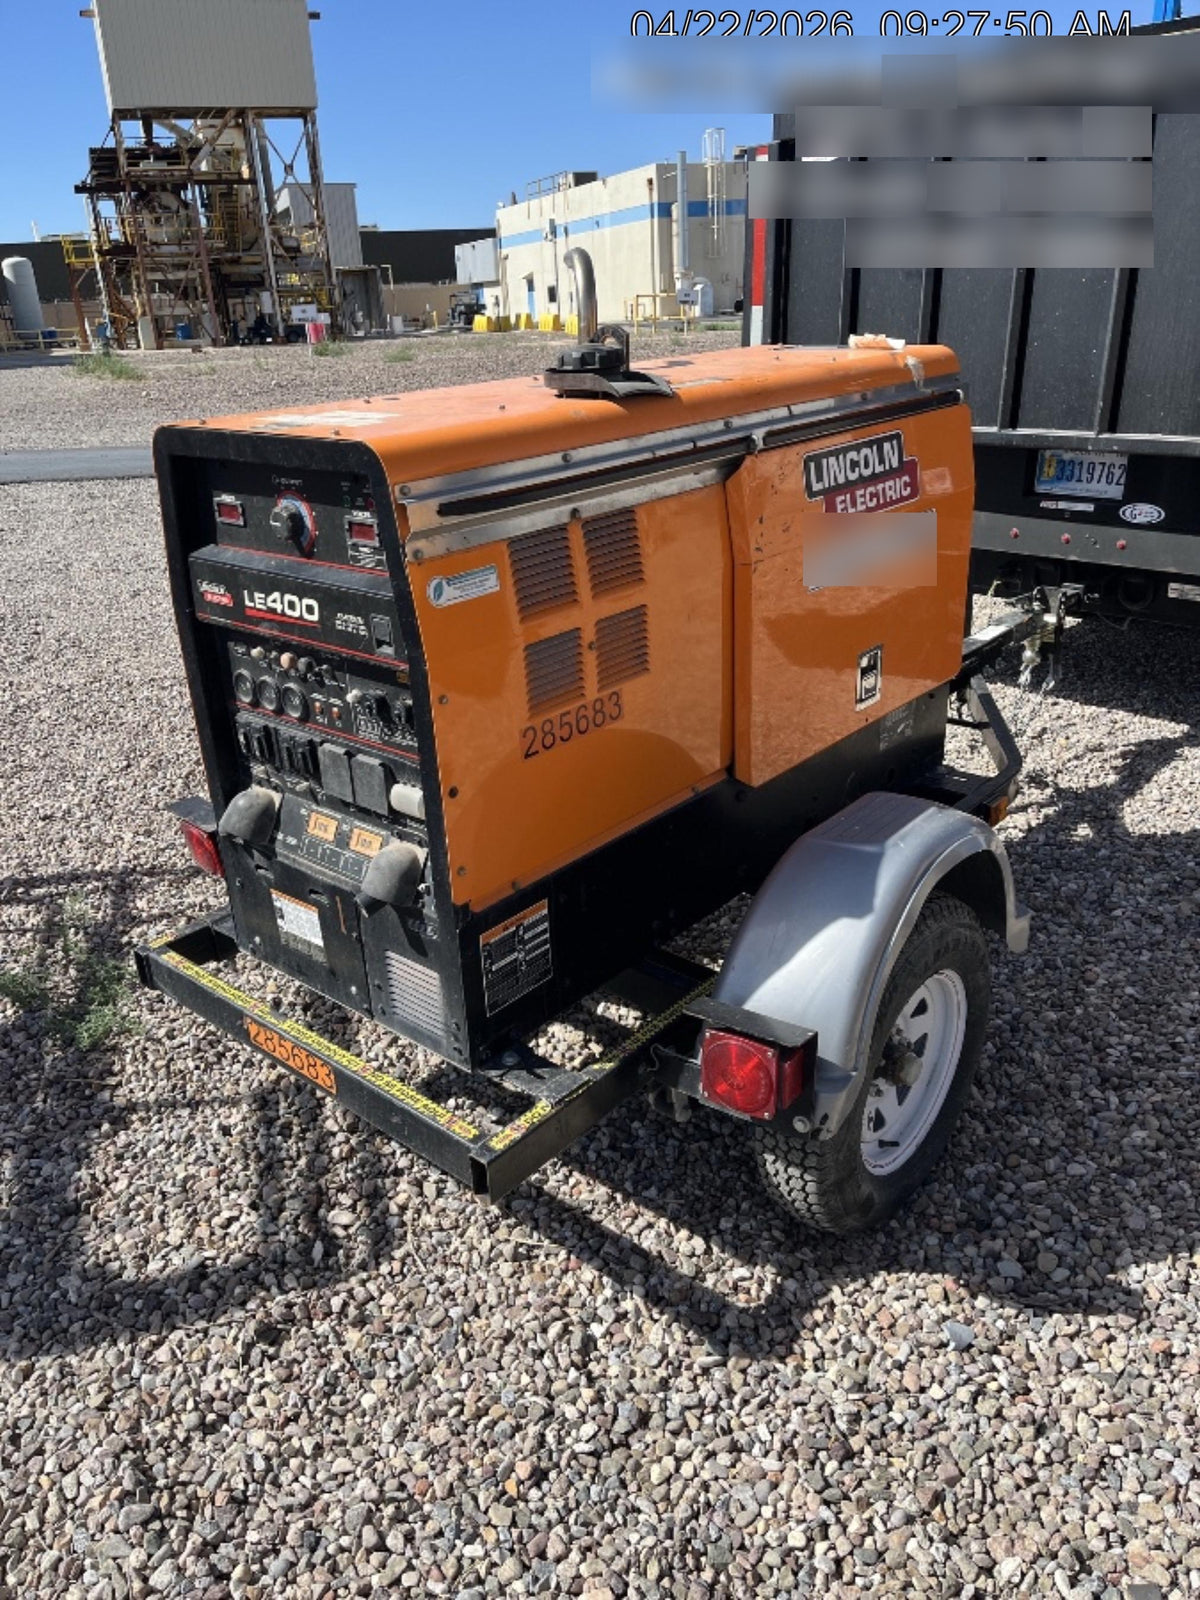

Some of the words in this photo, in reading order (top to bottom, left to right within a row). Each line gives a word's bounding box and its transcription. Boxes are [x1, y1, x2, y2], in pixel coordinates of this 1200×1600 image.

[809, 439, 899, 492] LINCOLN
[835, 475, 912, 513] ELECTRIC
[243, 589, 320, 622] LE400
[522, 691, 622, 760] 285683
[252, 1027, 334, 1089] 285683
